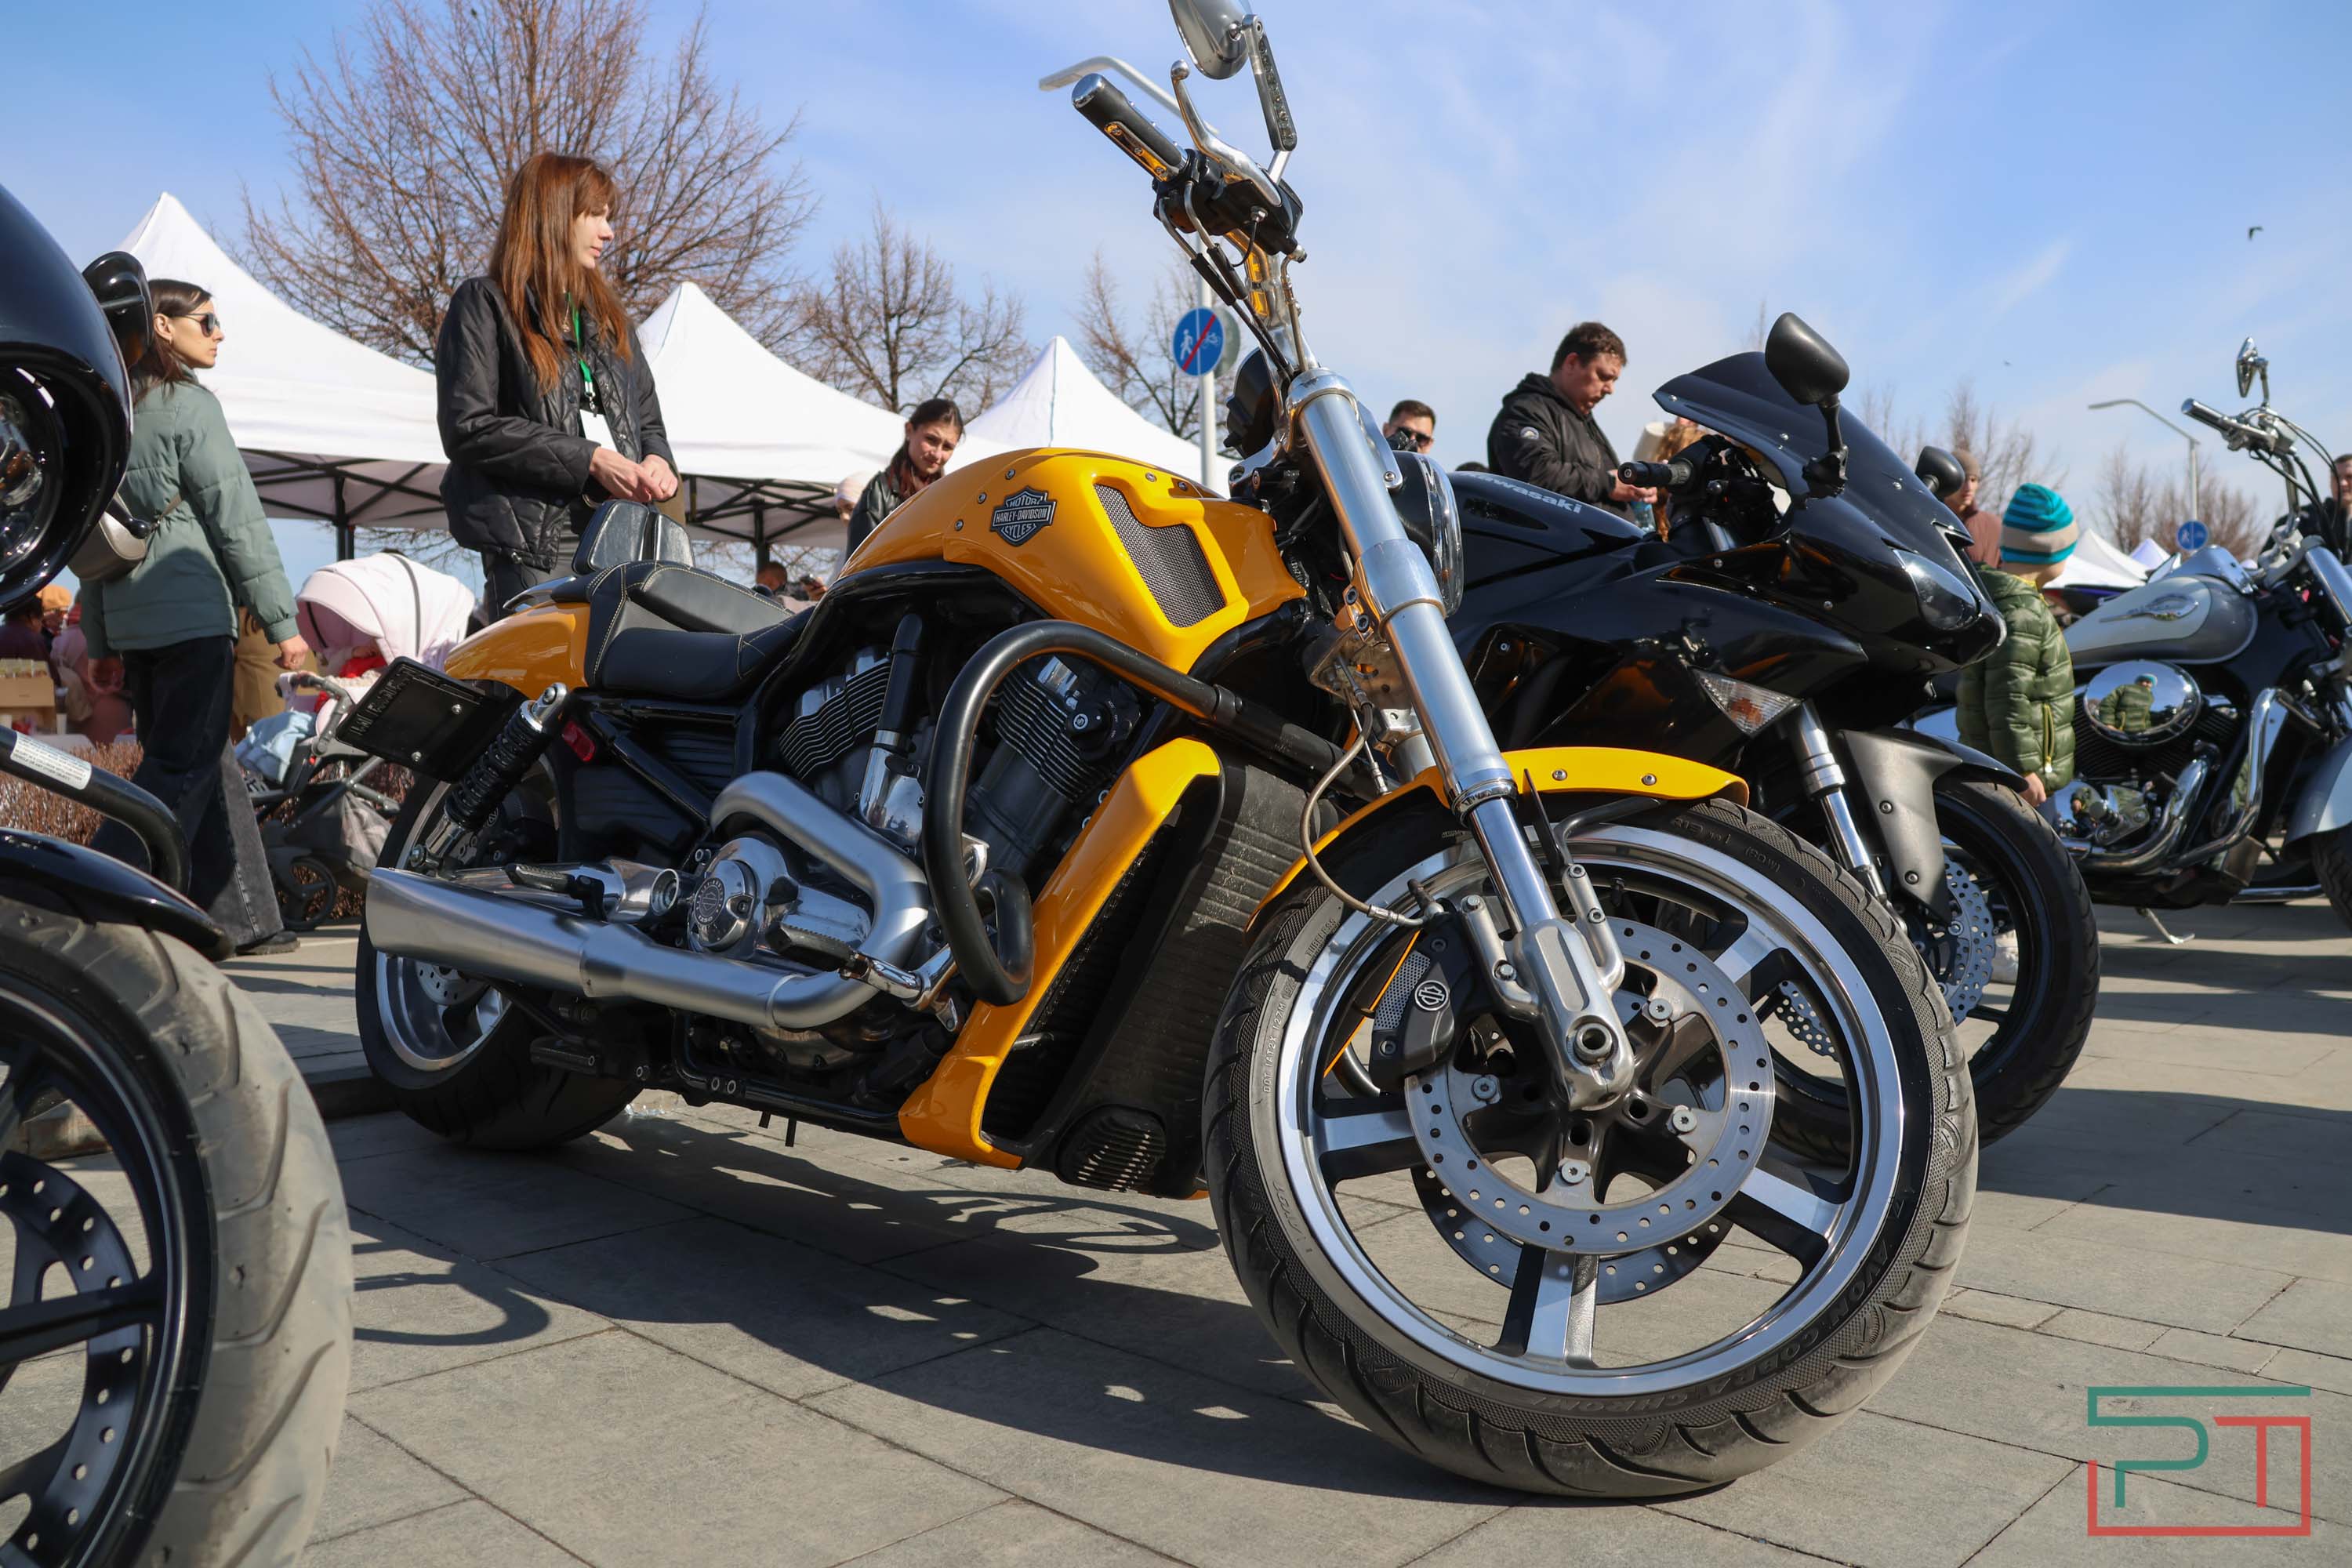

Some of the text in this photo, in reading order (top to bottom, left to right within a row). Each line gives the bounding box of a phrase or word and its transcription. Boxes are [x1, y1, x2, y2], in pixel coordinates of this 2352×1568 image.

[1010, 495, 1037, 507] MOTOR
[996, 508, 1047, 523] HARLEY-DAVIDSON
[1005, 524, 1032, 539] CYCLES
[1305, 917, 1337, 958] TUBELESS
[1262, 1073, 1272, 1093] DOT
